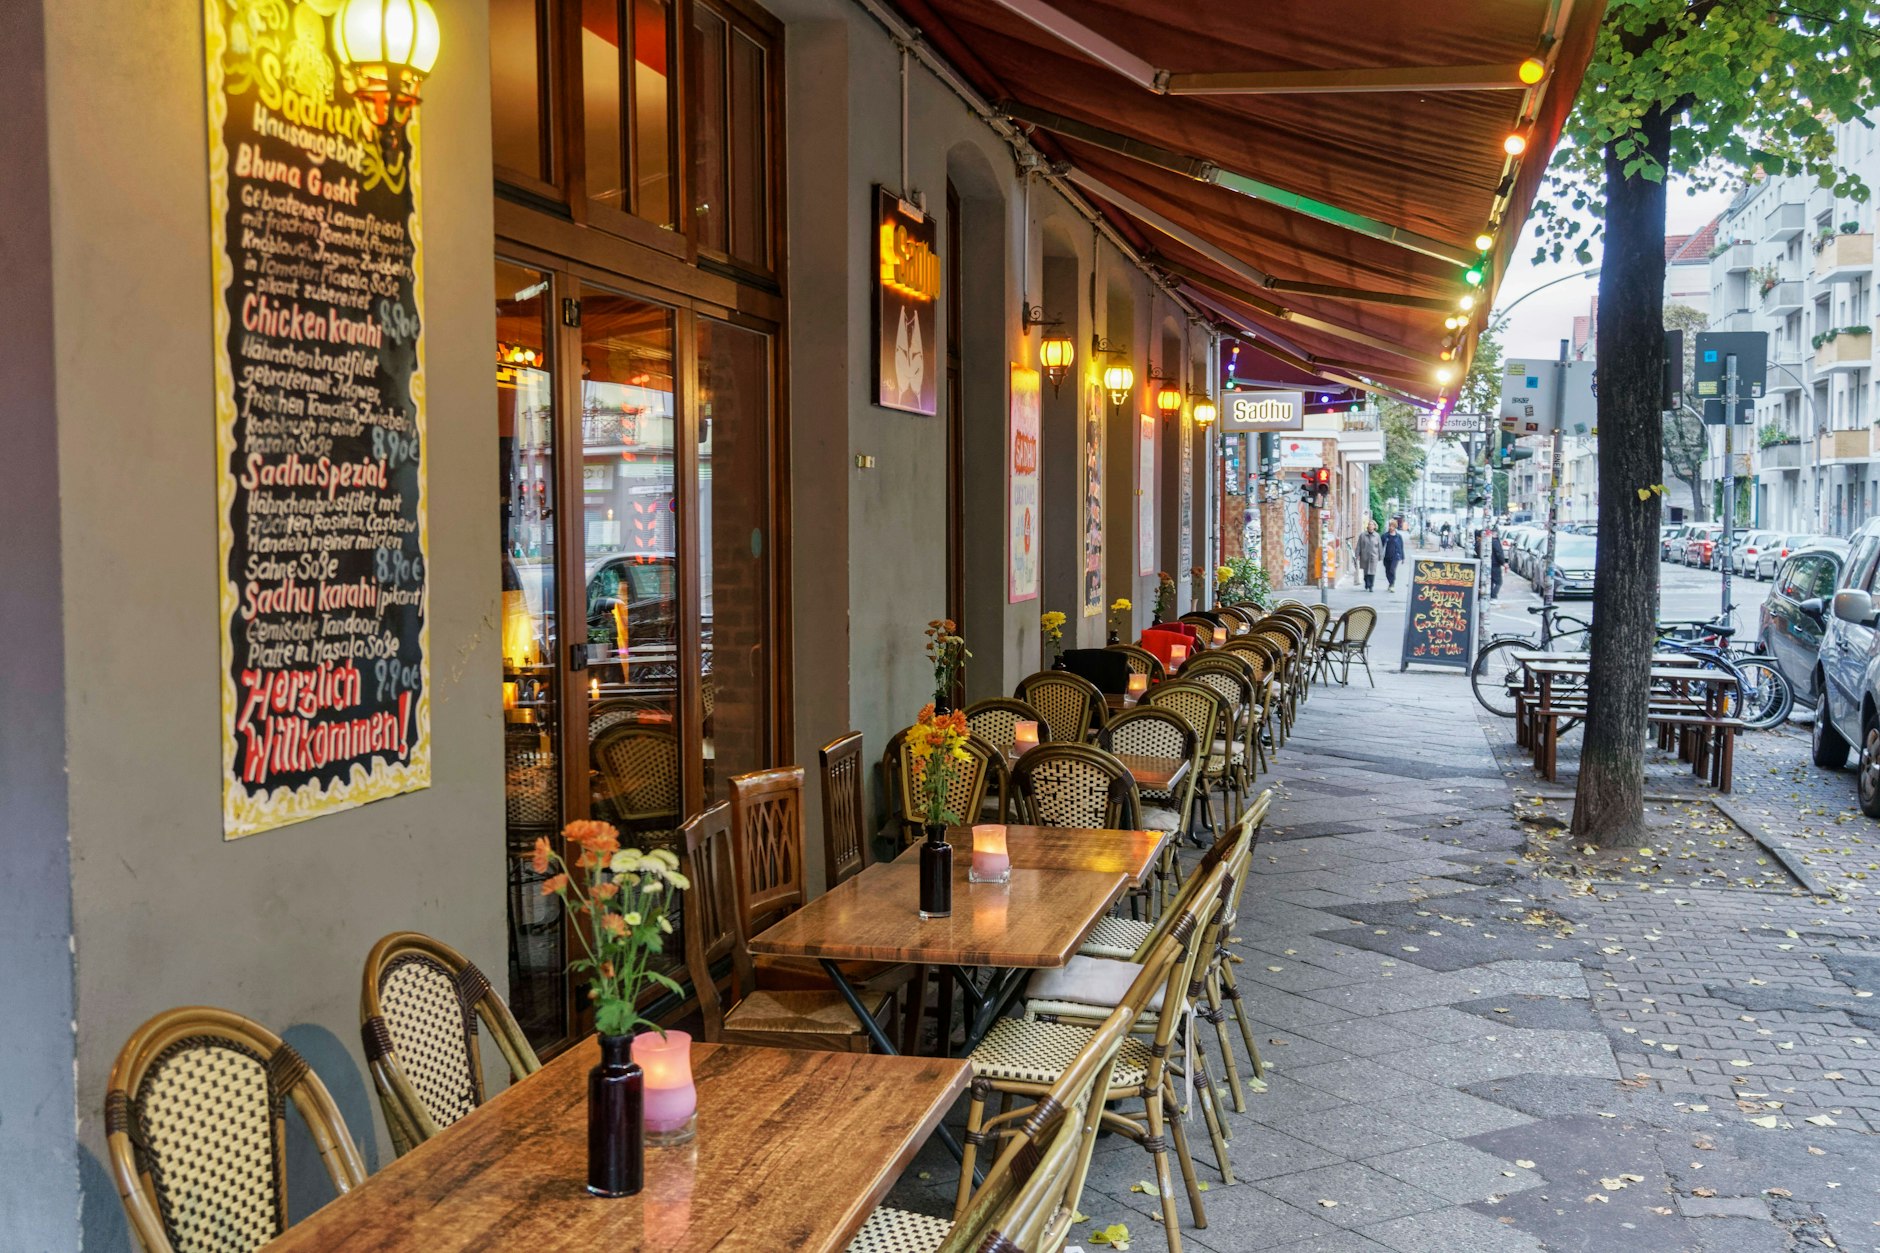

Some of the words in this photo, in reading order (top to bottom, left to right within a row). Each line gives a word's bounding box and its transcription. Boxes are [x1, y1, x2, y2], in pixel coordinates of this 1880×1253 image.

[258, 52, 353, 139] Sadhu
[253, 101, 365, 173] Hausangebot
[235, 142, 301, 189] Bhuna
[307, 167, 359, 206] Gosht
[241, 185, 325, 222] Gebratenes
[327, 202, 404, 240] Lammfleisch
[241, 212, 264, 230] mit
[265, 211, 318, 240] frischen
[244, 252, 257, 272] in
[894, 225, 941, 300] Sadhu
[257, 276, 299, 298] pikant
[304, 282, 373, 310] zubereitet
[242, 293, 326, 341] Chicken
[329, 307, 382, 349] karahi
[238, 365, 311, 391] gebraten
[311, 373, 333, 395] mit
[318, 416, 330, 434] in
[1235, 400, 1292, 421] Sadhu
[240, 452, 317, 490] Sadhu
[317, 453, 387, 501] Spezial
[378, 492, 402, 512] mit
[366, 513, 416, 534] Cashew
[248, 532, 309, 555] Mandeln
[355, 532, 403, 549] milden
[245, 554, 297, 580] Sahne
[298, 551, 338, 581] Soße
[1415, 560, 1474, 582] Sadhu
[241, 578, 315, 620] Sadhu
[318, 576, 377, 611] karahi
[1418, 585, 1464, 608] Happy
[246, 614, 318, 643] Gemischte
[321, 610, 382, 636] Tandoori
[1414, 613, 1467, 632] Cocktails
[247, 642, 294, 669] Platte
[295, 640, 309, 663] in
[311, 635, 365, 664] Masala
[365, 630, 399, 659] Soße
[238, 659, 361, 731] Herzlich
[242, 691, 412, 783] Willkommen!
